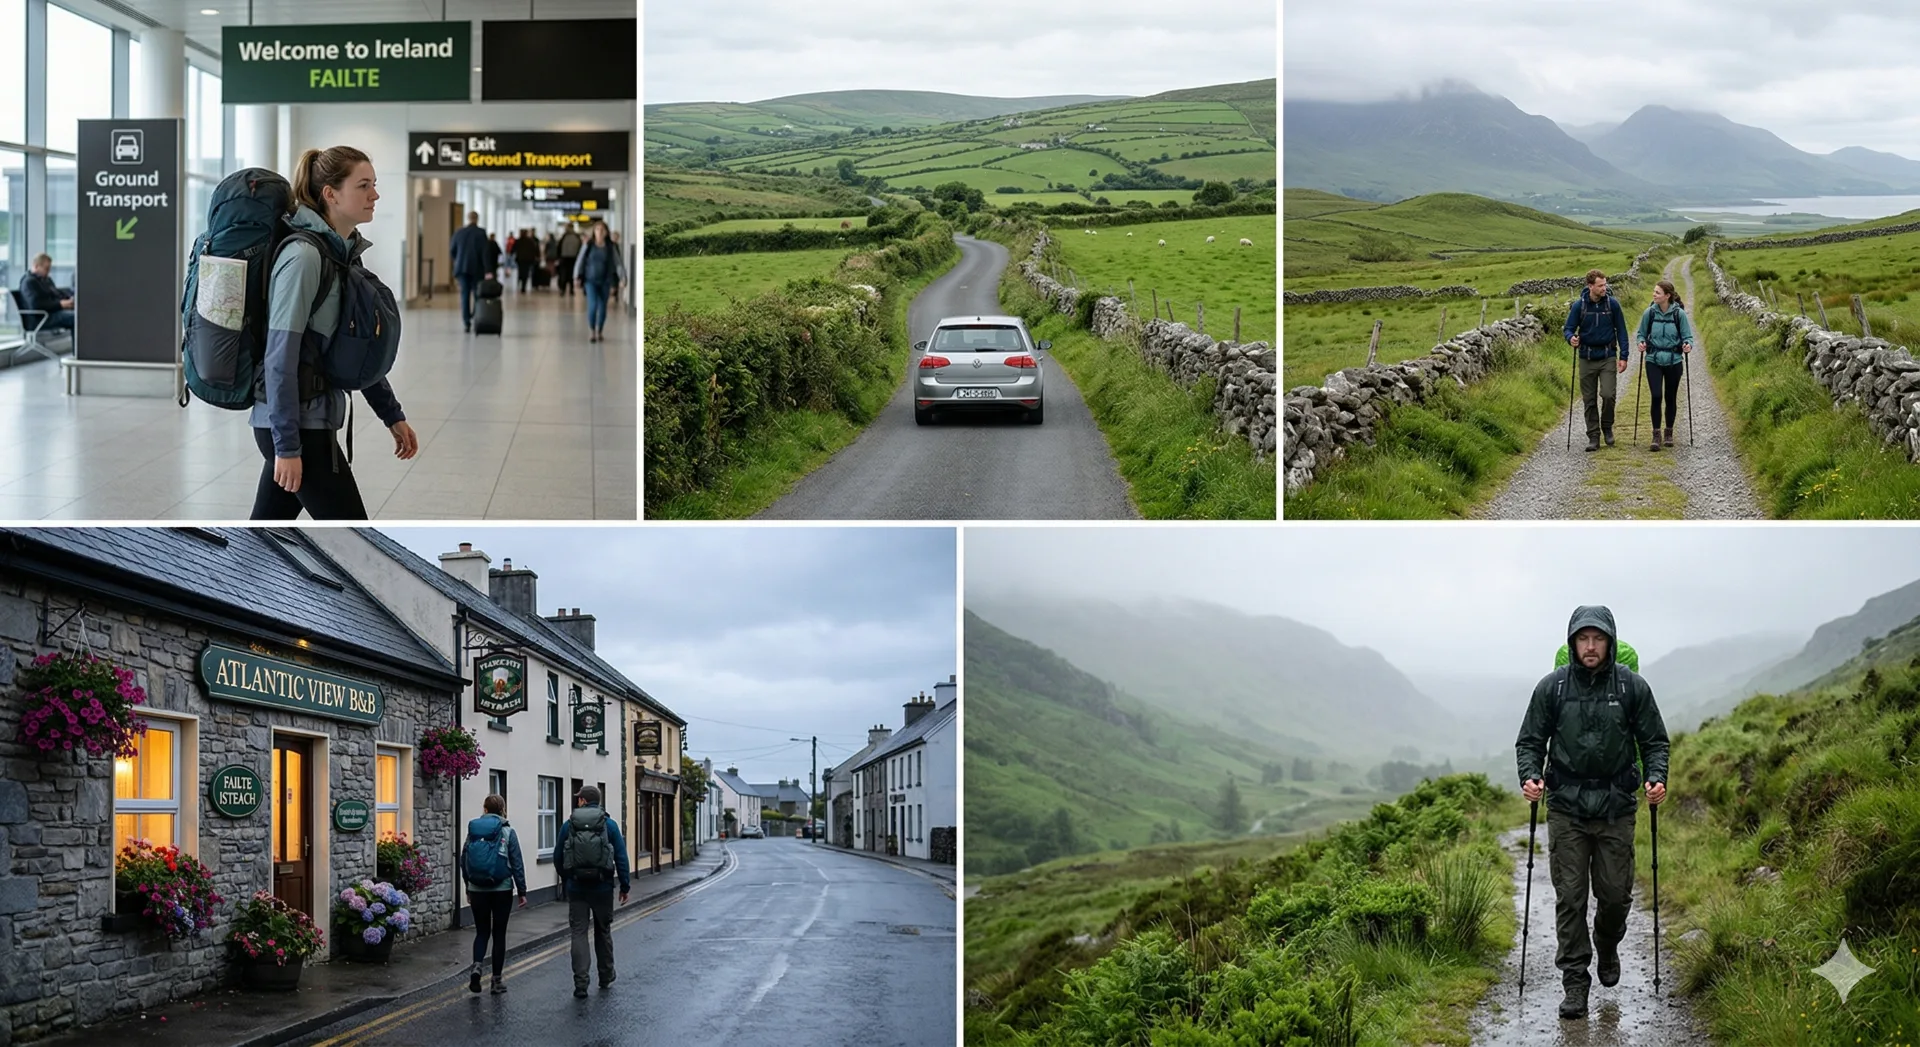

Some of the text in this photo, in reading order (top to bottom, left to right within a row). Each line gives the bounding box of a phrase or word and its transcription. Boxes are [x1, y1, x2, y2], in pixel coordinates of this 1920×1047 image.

[238, 37, 453, 61] Welcome to Ireland
[309, 68, 380, 88] FAILTE
[468, 137, 496, 151] Exit
[467, 152, 592, 168] Ground Transport
[95, 170, 159, 187] Ground
[86, 191, 168, 211] Transport
[215, 657, 376, 715] ATLANTIC VIEW B&B
[223, 775, 253, 790] FAILTE
[219, 791, 256, 805] ISTEACH
